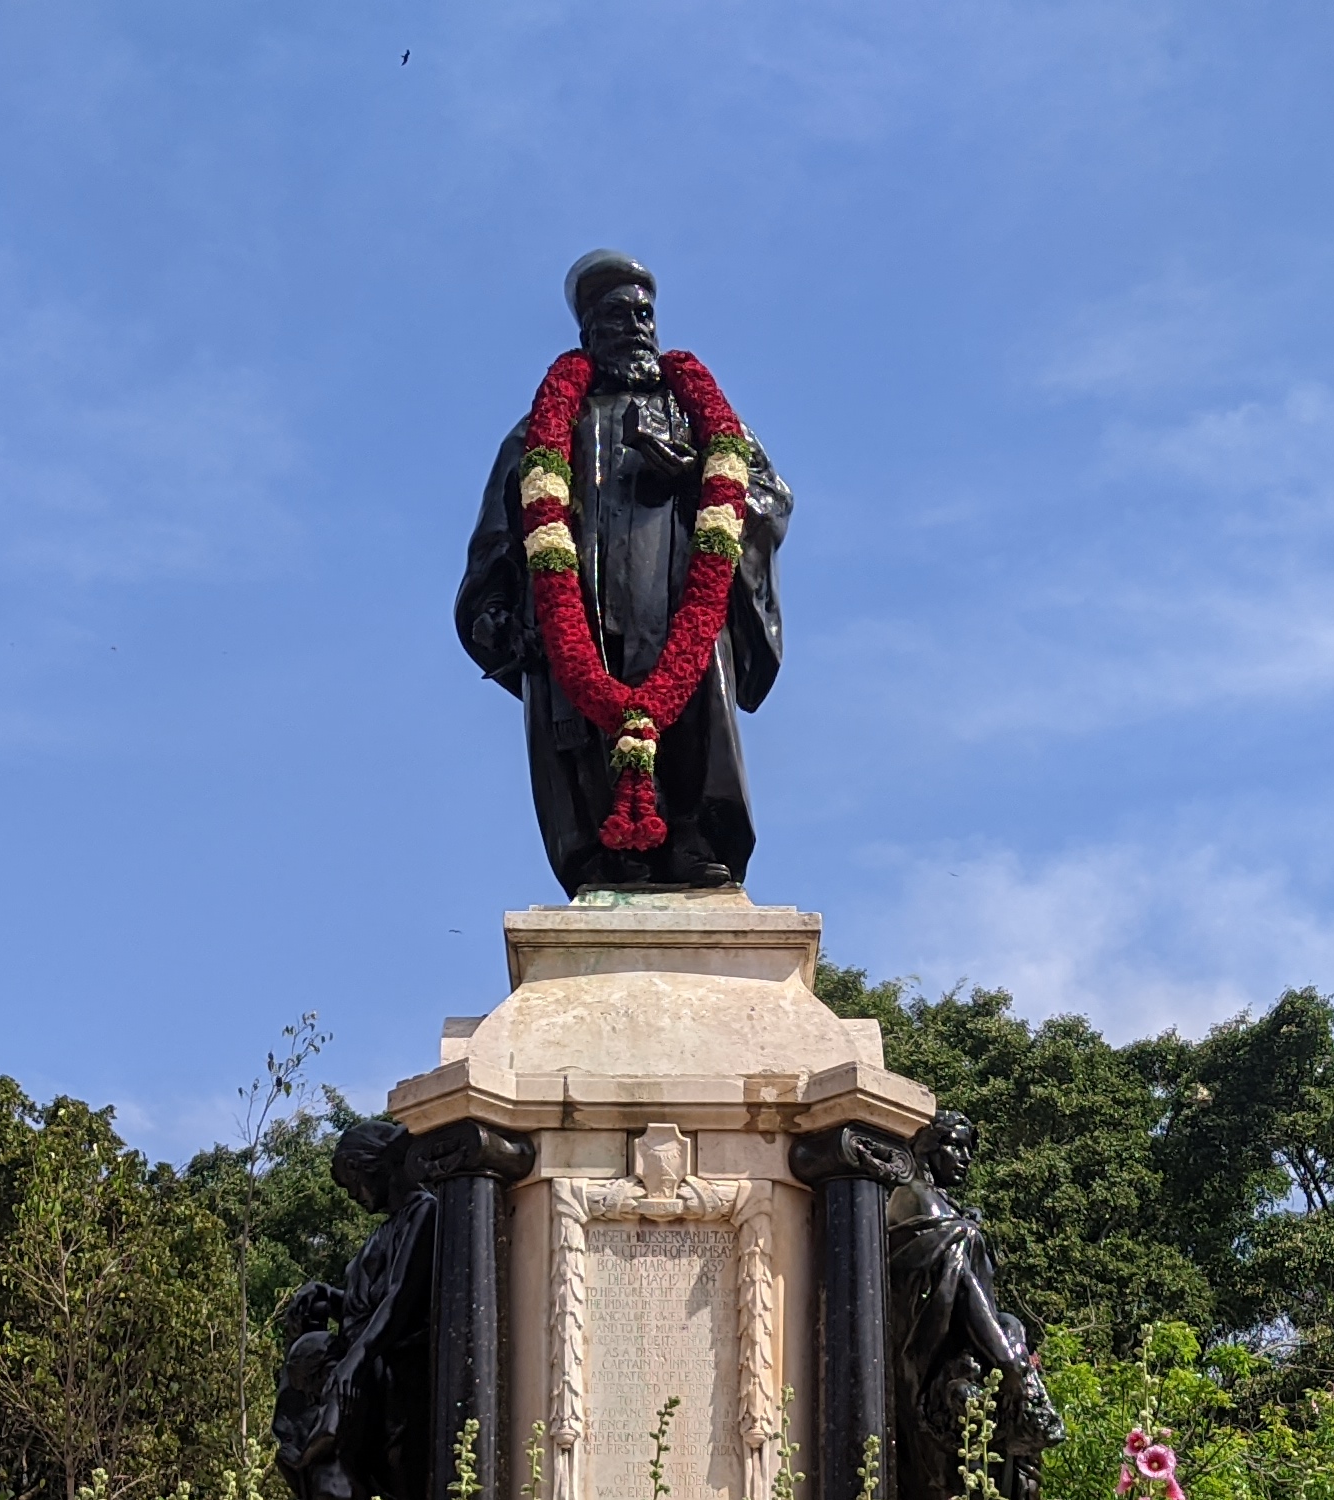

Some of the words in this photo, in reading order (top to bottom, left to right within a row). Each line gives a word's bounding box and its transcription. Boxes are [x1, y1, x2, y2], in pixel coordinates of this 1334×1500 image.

[585, 1287, 598, 1298] TO
[600, 1287, 617, 1298] HIS
[618, 1287, 674, 1298] FORESIGHT
[585, 1299, 602, 1310] THE
[604, 1299, 638, 1310] INDIAN
[641, 1299, 689, 1310] INSTITUTE
[591, 1311, 652, 1321] BANGALORE
[654, 1311, 682, 1321] OWES
[595, 1323, 617, 1334] AND
[619, 1323, 633, 1334] TO
[636, 1323, 652, 1334] HIS
[622, 1335, 646, 1346] PART
[603, 1347, 619, 1358] AS
[622, 1347, 630, 1358] A
[602, 1359, 651, 1370] CAPTAIN
[591, 1371, 614, 1382] AND
[618, 1371, 659, 1382] PATRON
[662, 1371, 676, 1382] OF
[603, 1383, 661, 1394] PERCEIVED
[664, 1383, 684, 1394] THE
[617, 1395, 632, 1406] TO
[635, 1395, 651, 1406] HIS
[585, 1407, 598, 1419] OF
[584, 1420, 629, 1430] SCIENCE
[583, 1431, 604, 1442] AND
[607, 1443, 636, 1455] FIRST
[673, 1444, 697, 1456] KIND
[624, 1461, 648, 1473] THIS
[614, 1474, 628, 1485] OF
[633, 1474, 651, 1486] ITS
[661, 1474, 710, 1486] OUNDER
[595, 1486, 623, 1498] WAS
[627, 1486, 680, 1498] ERECD
[684, 1487, 694, 1498] IN
